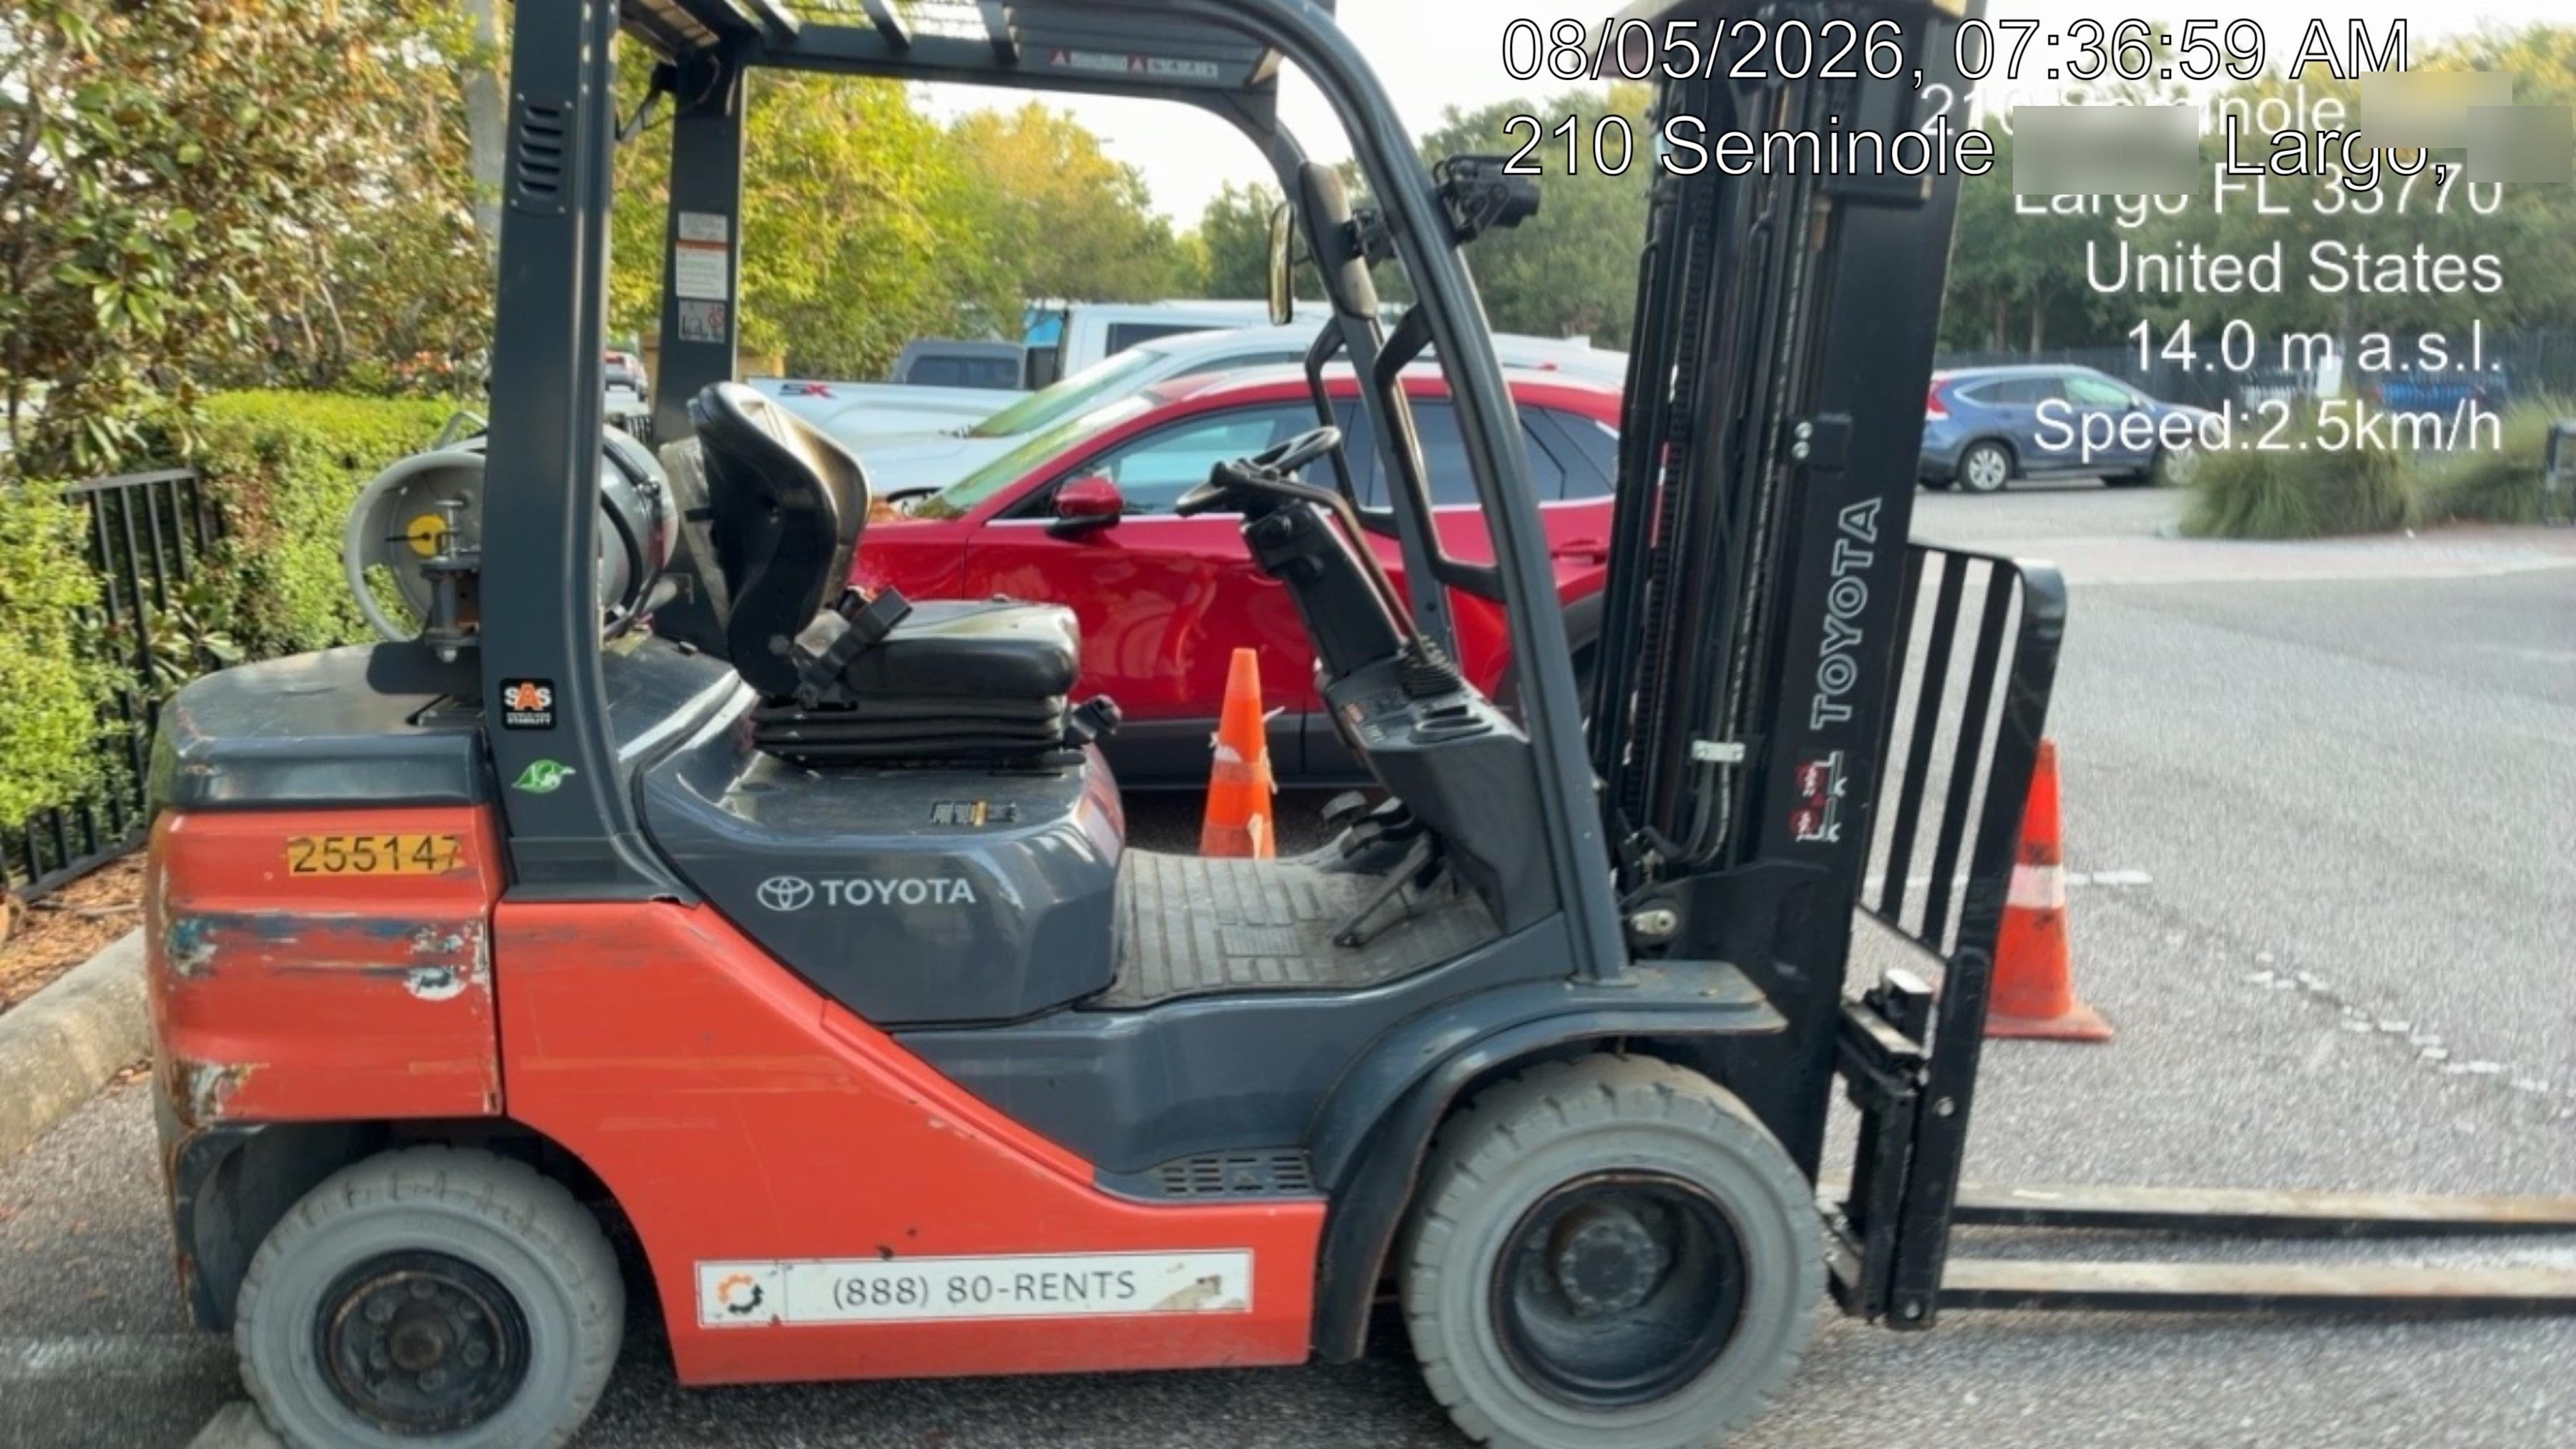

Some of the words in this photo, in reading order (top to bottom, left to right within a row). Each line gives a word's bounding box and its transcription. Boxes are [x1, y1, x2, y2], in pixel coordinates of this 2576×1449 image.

[1810, 497, 1883, 731] TOYOTA
[504, 682, 552, 711] SAS
[288, 836, 462, 872] 255147
[820, 877, 977, 906] TOYOTA
[833, 1277, 929, 1310] (888)
[946, 1270, 1136, 1304] 80-RENTS
